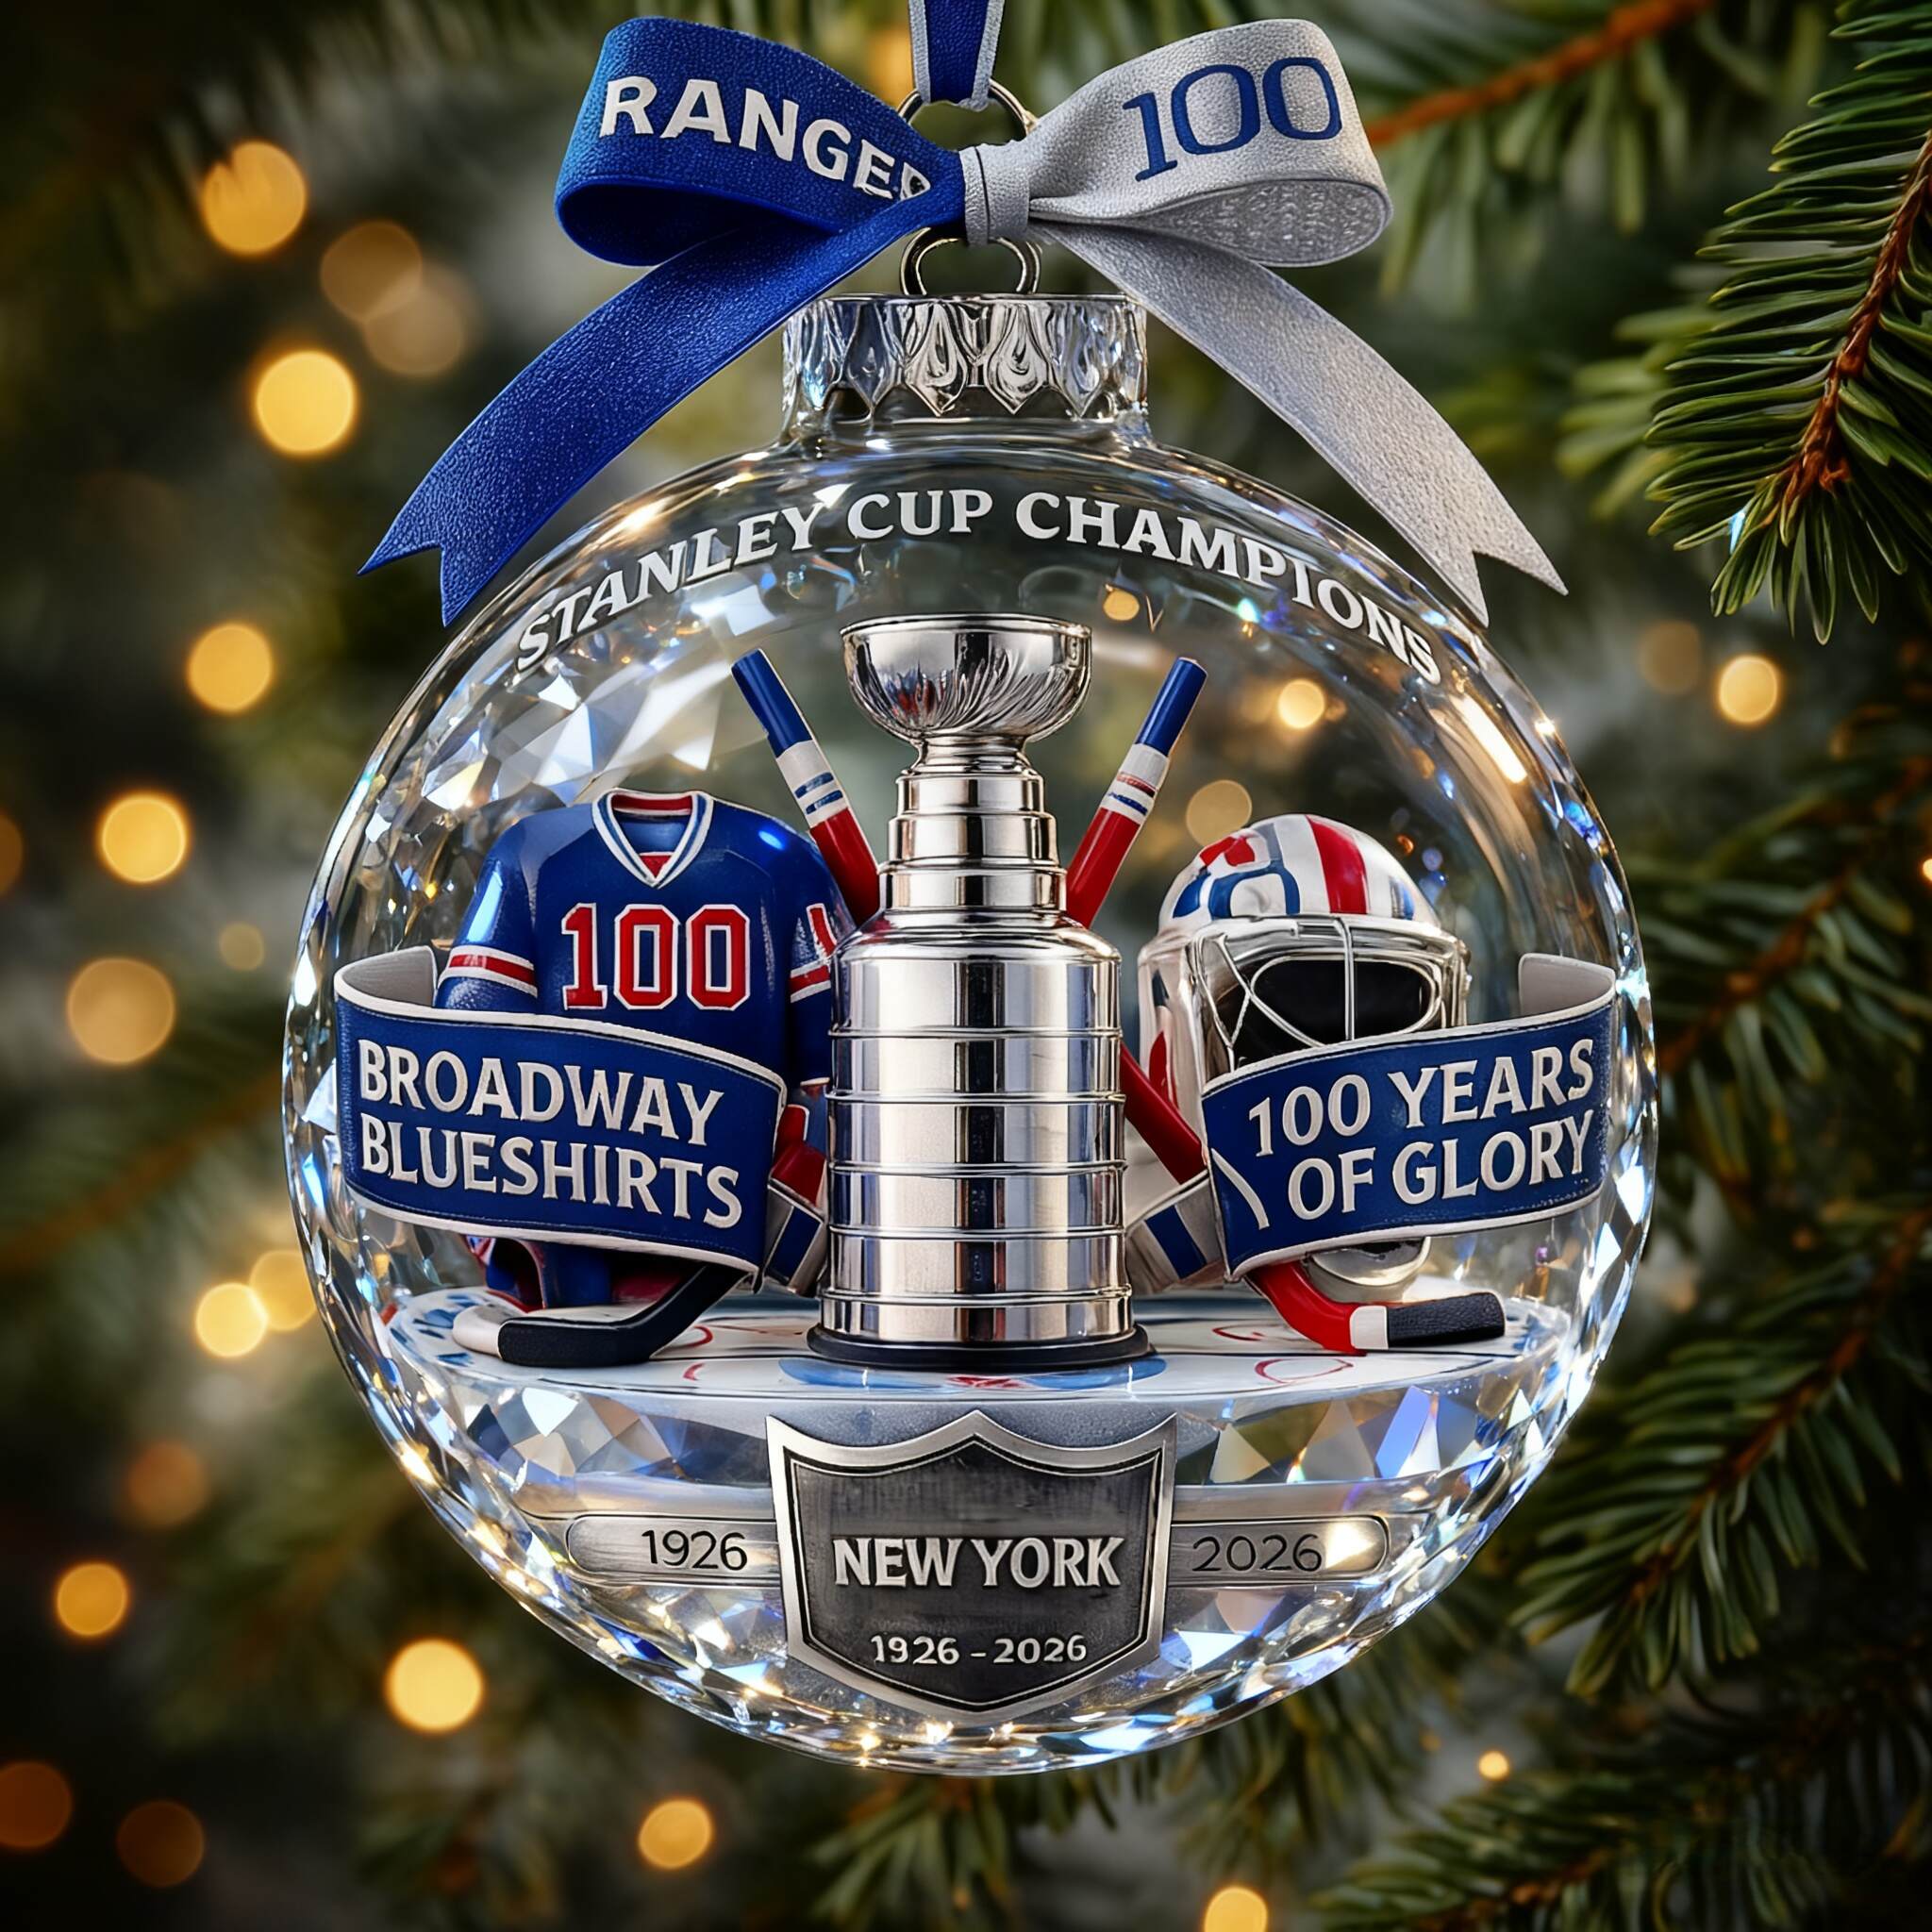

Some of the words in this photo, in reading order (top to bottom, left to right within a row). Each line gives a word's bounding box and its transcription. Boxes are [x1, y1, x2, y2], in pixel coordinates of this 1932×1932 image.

[1123, 57, 1342, 181] 100
[516, 503, 824, 672] STANLEY
[849, 489, 993, 540] CUP
[1016, 491, 1441, 684] CHAMPIONS
[561, 903, 751, 1010] 100
[358, 1040, 724, 1146] BROADWAY
[1248, 1074, 1371, 1158] 100
[1387, 1039, 1594, 1128] YEARS
[360, 1112, 741, 1229] BLUESHIRTS
[1288, 1148, 1376, 1221] OF
[1392, 1109, 1594, 1205] GLORY
[641, 1529, 748, 1571] 1926
[833, 1538, 962, 1588] NEW
[971, 1537, 1125, 1589] YORK
[1191, 1533, 1323, 1572] 2026
[870, 1635, 959, 1665] 1926
[992, 1634, 1088, 1664] 2026
